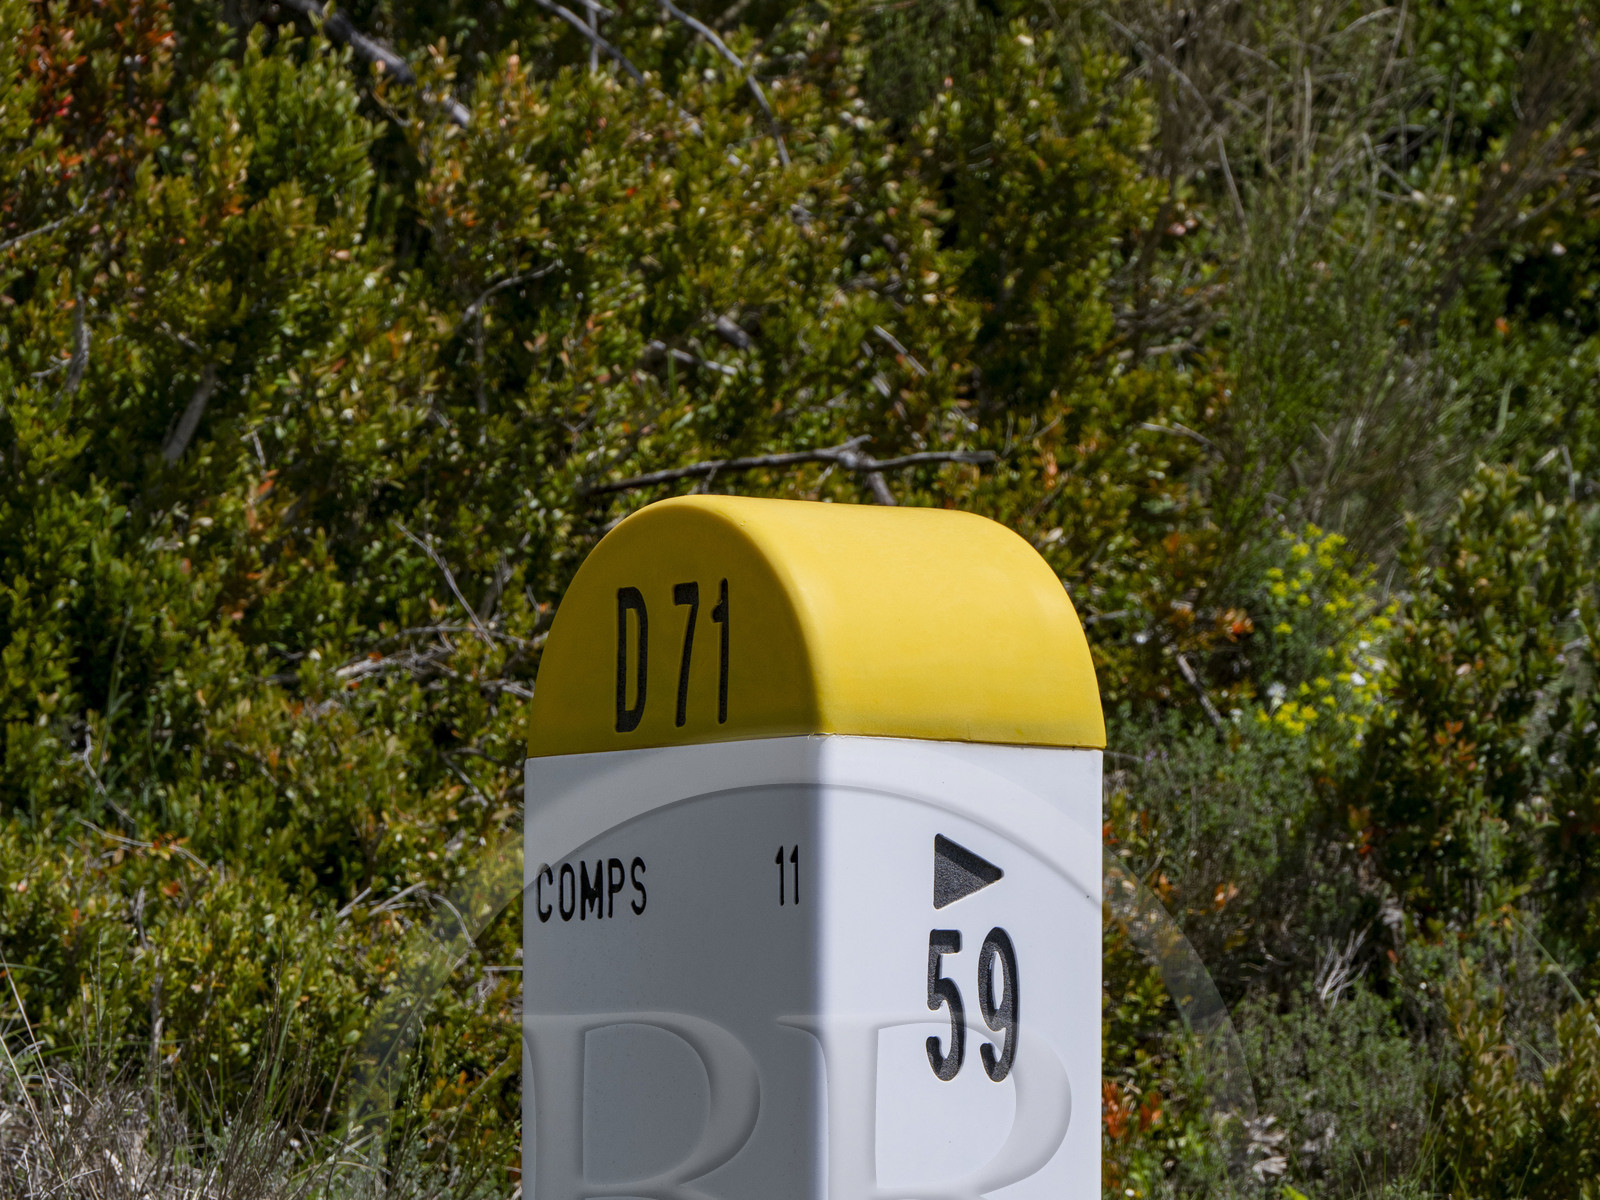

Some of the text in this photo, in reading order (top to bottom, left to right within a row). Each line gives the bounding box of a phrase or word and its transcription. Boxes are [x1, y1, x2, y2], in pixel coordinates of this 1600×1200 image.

[615, 578, 730, 733] D 71
[536, 845, 800, 922] COMPS 11
[925, 926, 1020, 1082] 59
